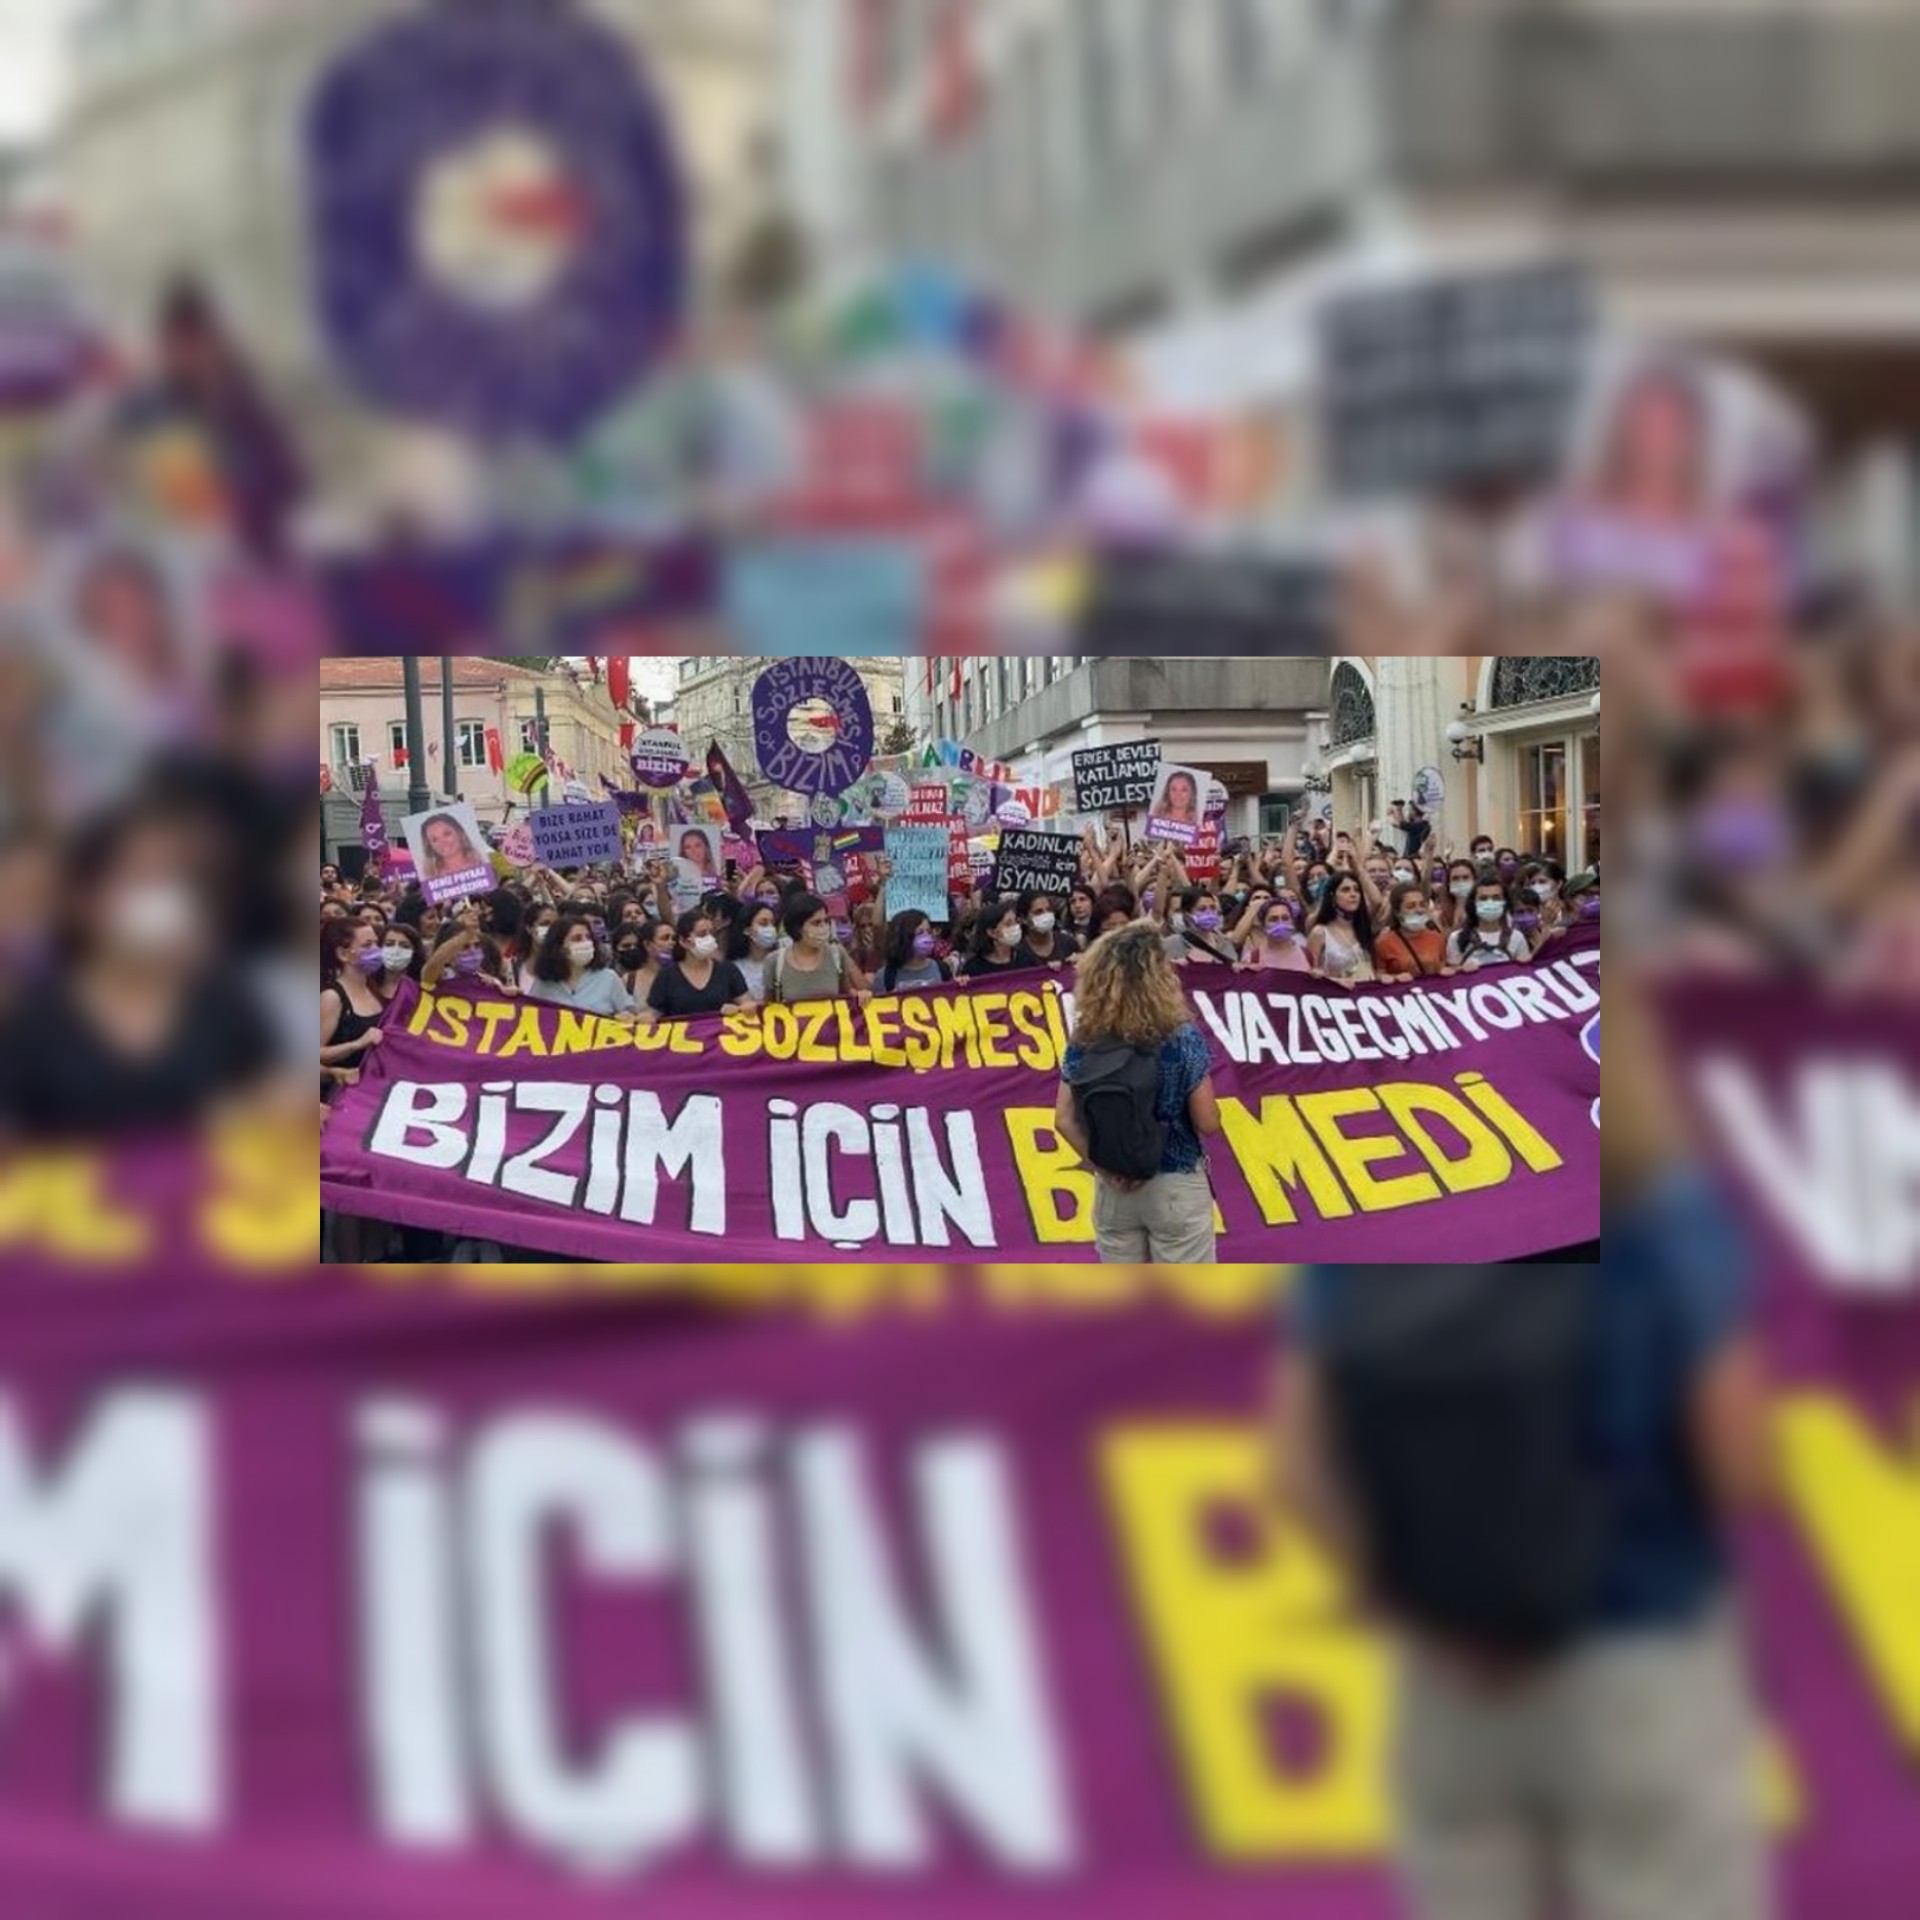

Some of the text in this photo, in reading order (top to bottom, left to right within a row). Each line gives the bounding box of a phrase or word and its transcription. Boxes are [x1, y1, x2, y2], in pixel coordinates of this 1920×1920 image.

[1074, 744, 1160, 767] ERKEK DEVLET
[568, 809, 604, 823] RAHAT
[603, 823, 617, 838] DE
[587, 842, 611, 857] YOK
[370, 1080, 726, 1236] BİZİM
[768, 1098, 998, 1249] İÇİN
